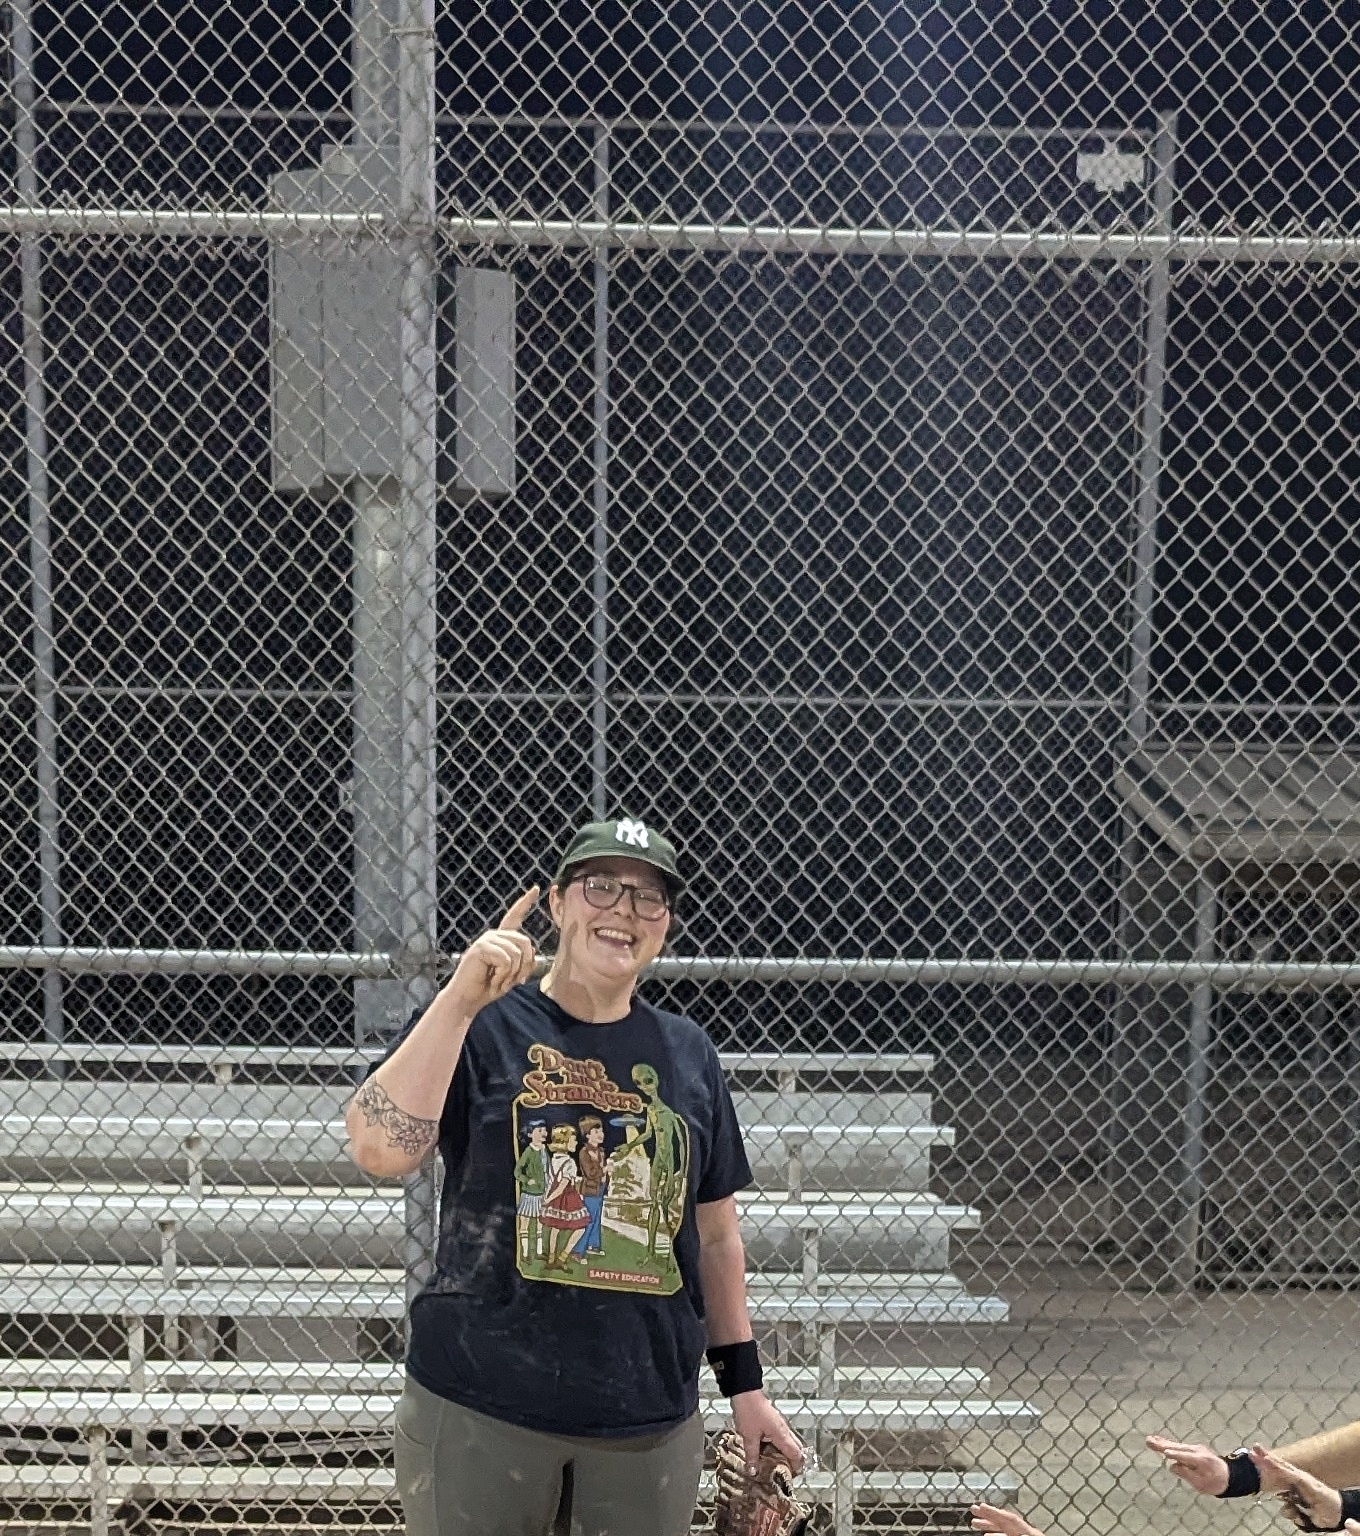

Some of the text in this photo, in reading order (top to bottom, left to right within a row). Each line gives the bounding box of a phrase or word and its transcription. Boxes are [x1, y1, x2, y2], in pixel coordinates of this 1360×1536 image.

[615, 817, 649, 848] NY
[523, 1070, 643, 1113] Strangers
[589, 1269, 660, 1284] SAFETY EDUCATION
